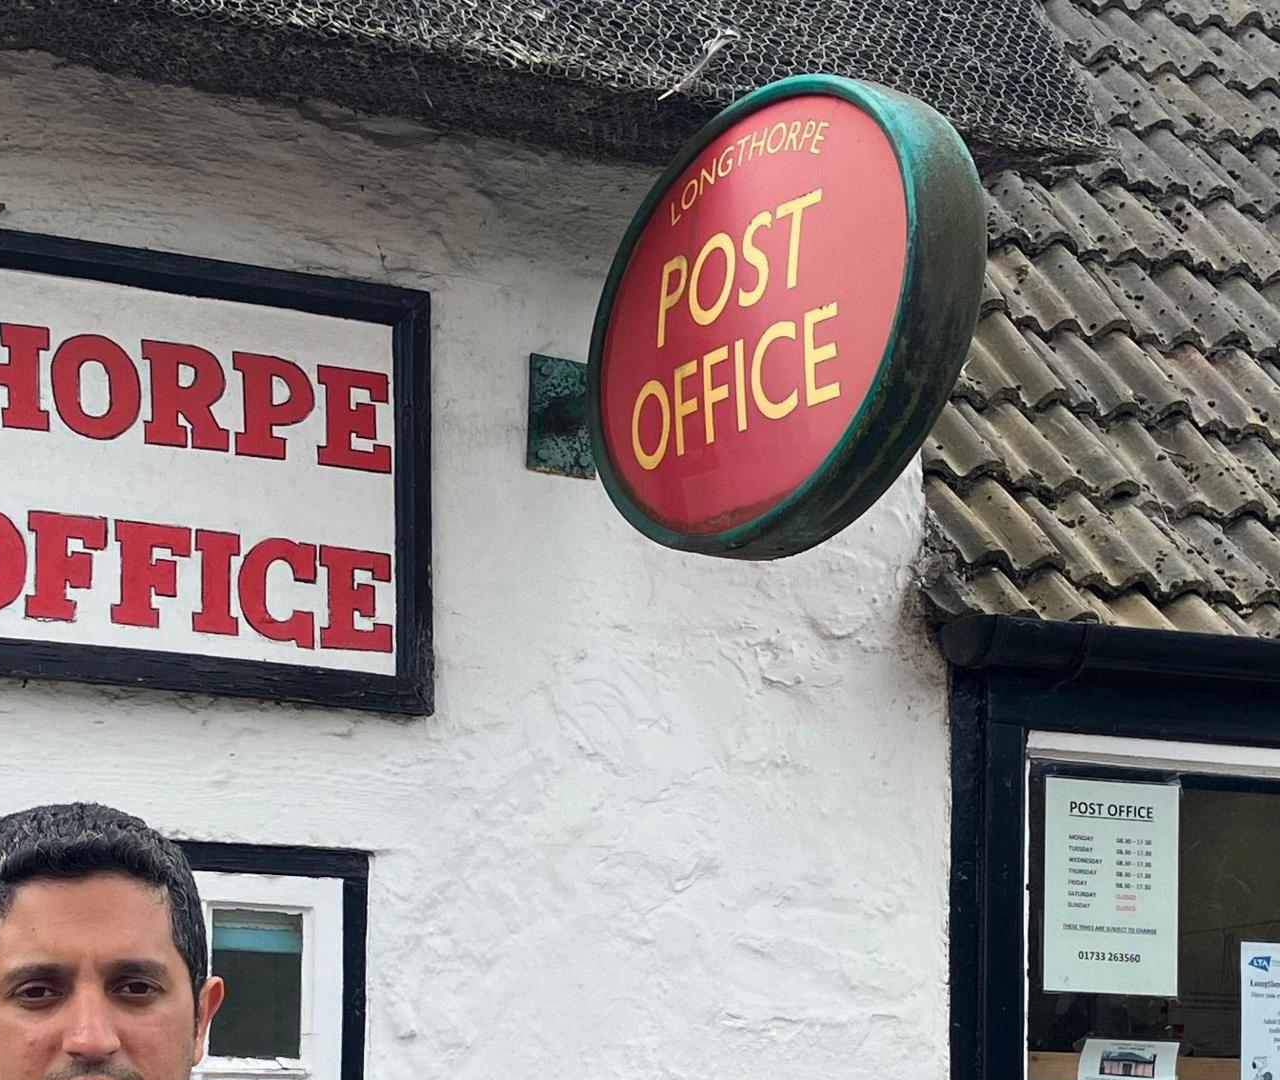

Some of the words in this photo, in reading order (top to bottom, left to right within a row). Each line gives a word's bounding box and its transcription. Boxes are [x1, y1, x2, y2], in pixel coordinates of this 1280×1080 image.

[669, 119, 830, 226] LONGTHORPE
[656, 188, 823, 348] POST
[631, 302, 841, 470] OFFICE
[1069, 801, 1104, 815] POST
[1107, 804, 1154, 819] OFFICE
[1068, 890, 1096, 898] SATURDAY
[1078, 950, 1106, 960] 01733
[1108, 952, 1141, 963] 263560
